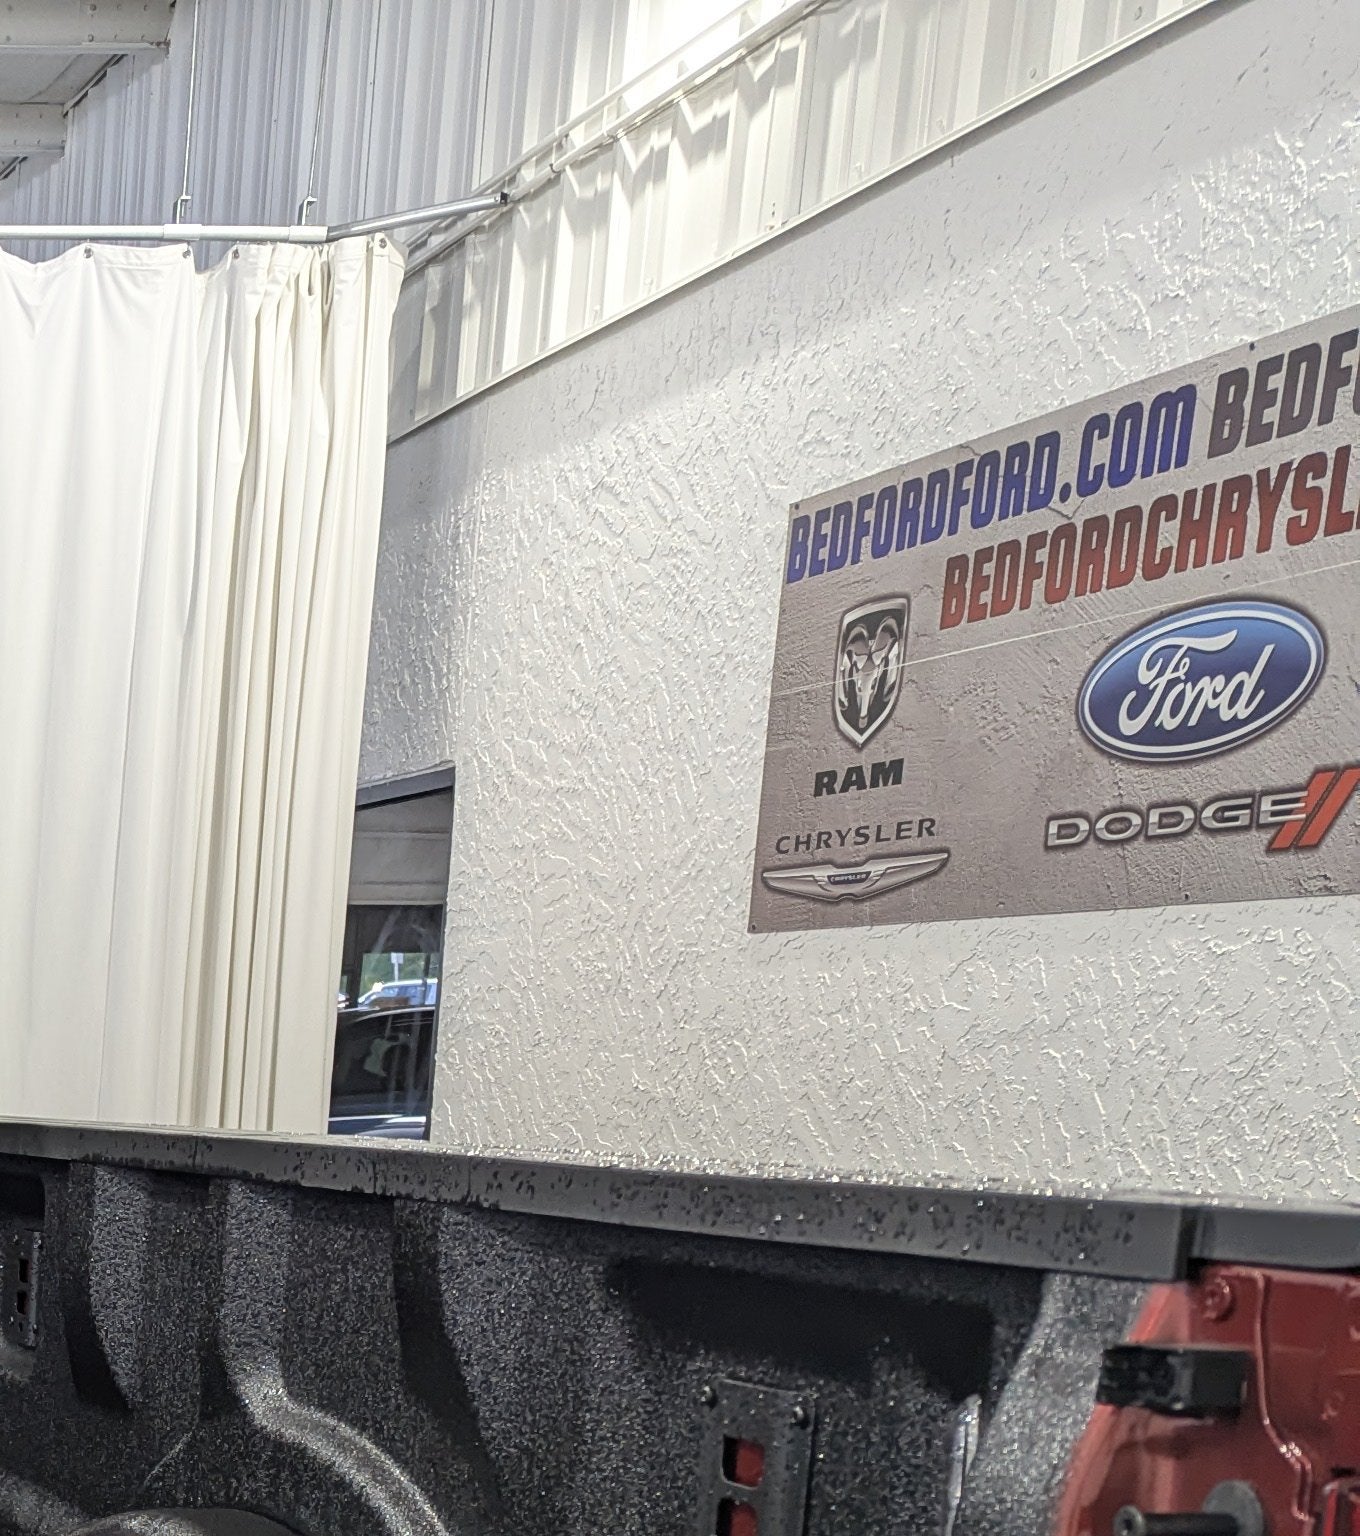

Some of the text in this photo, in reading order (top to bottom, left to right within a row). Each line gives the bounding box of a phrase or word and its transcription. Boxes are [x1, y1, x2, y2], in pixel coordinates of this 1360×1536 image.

[786, 328, 1360, 584] BEDFORDFORD.COM BEDF
[940, 444, 1360, 631] BEDFORDCHRYSL
[1118, 629, 1276, 736] Ford
[814, 758, 904, 797] RAM
[775, 818, 937, 854] CHRYSLER
[1045, 790, 1309, 848] DODGE
